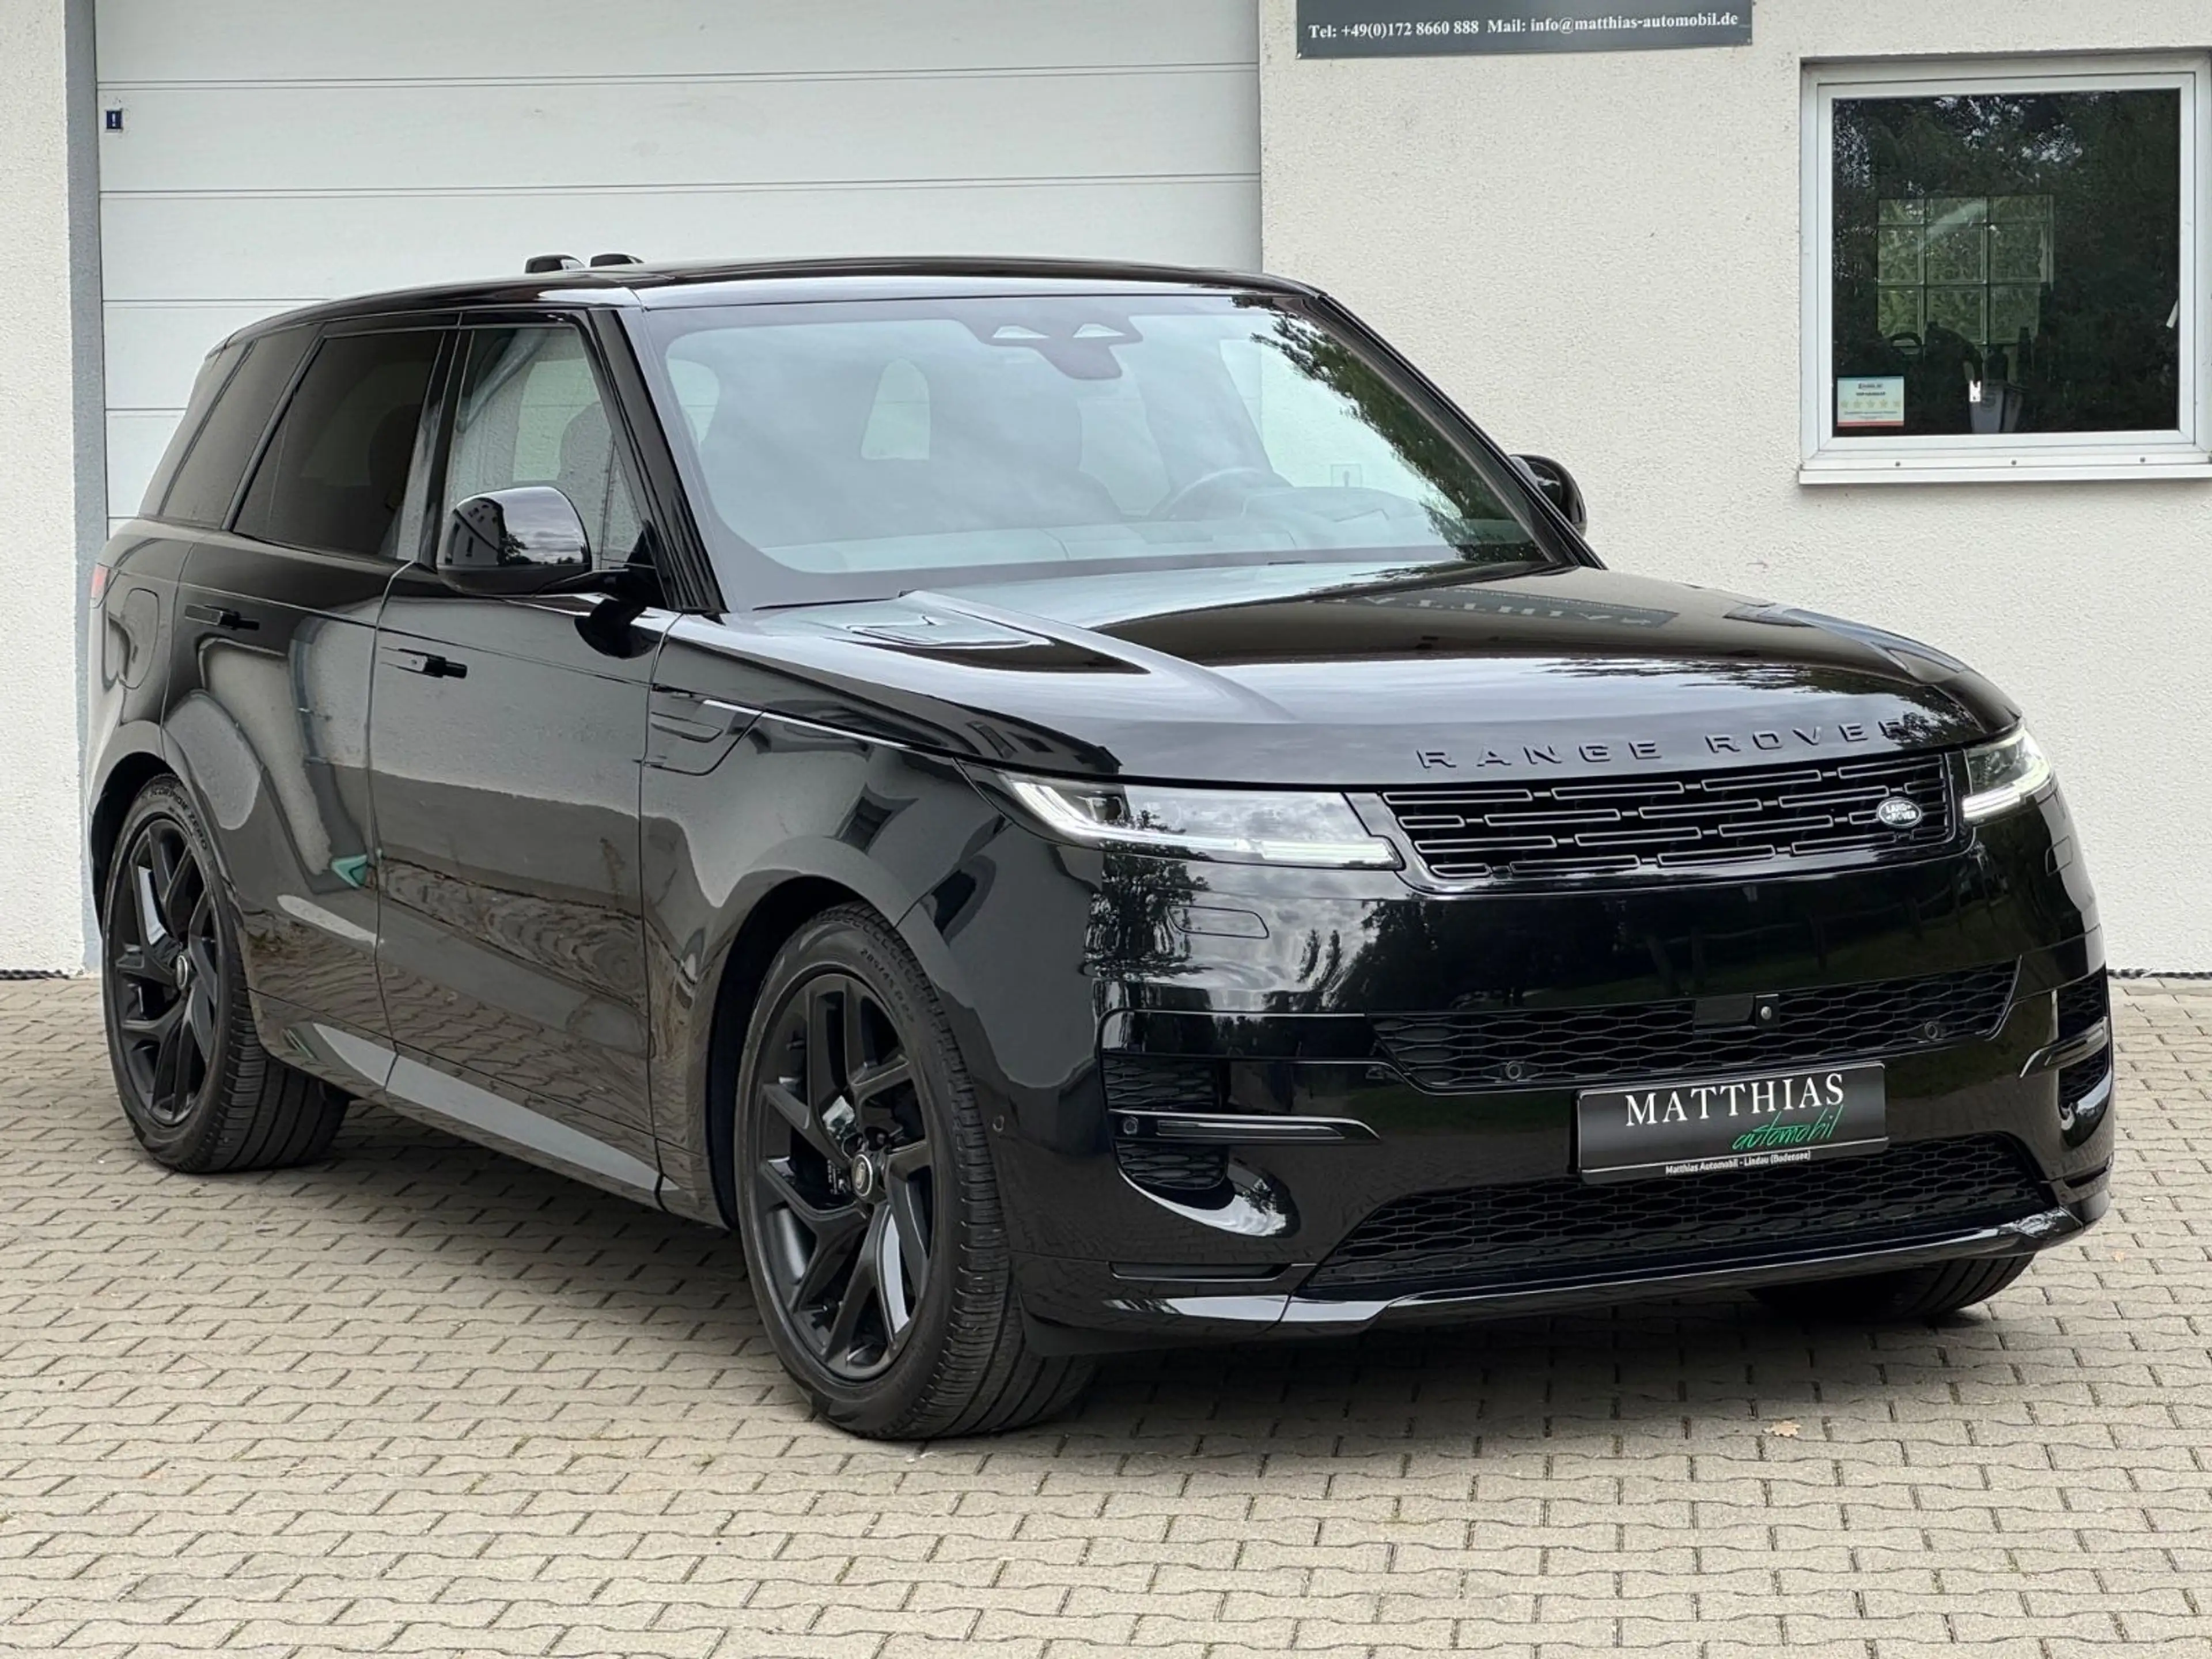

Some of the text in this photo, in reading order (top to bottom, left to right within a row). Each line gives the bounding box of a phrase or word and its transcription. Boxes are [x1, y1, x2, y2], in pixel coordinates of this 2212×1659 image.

[1309, 12, 1738, 39] Tel: +49(0)172 8660 888 Mail: info@matthias-automobil.de
[1416, 718, 1914, 769] RANGE ROVER
[1624, 1073, 1844, 1127] MATTHIAS
[1732, 1104, 1844, 1151] automobil
[1665, 1162, 1698, 1175] Matthias
[1699, 1158, 1738, 1172] Automobil
[1744, 1155, 1770, 1167] Lindau
[1770, 1150, 1811, 1165] (Bodensee)
